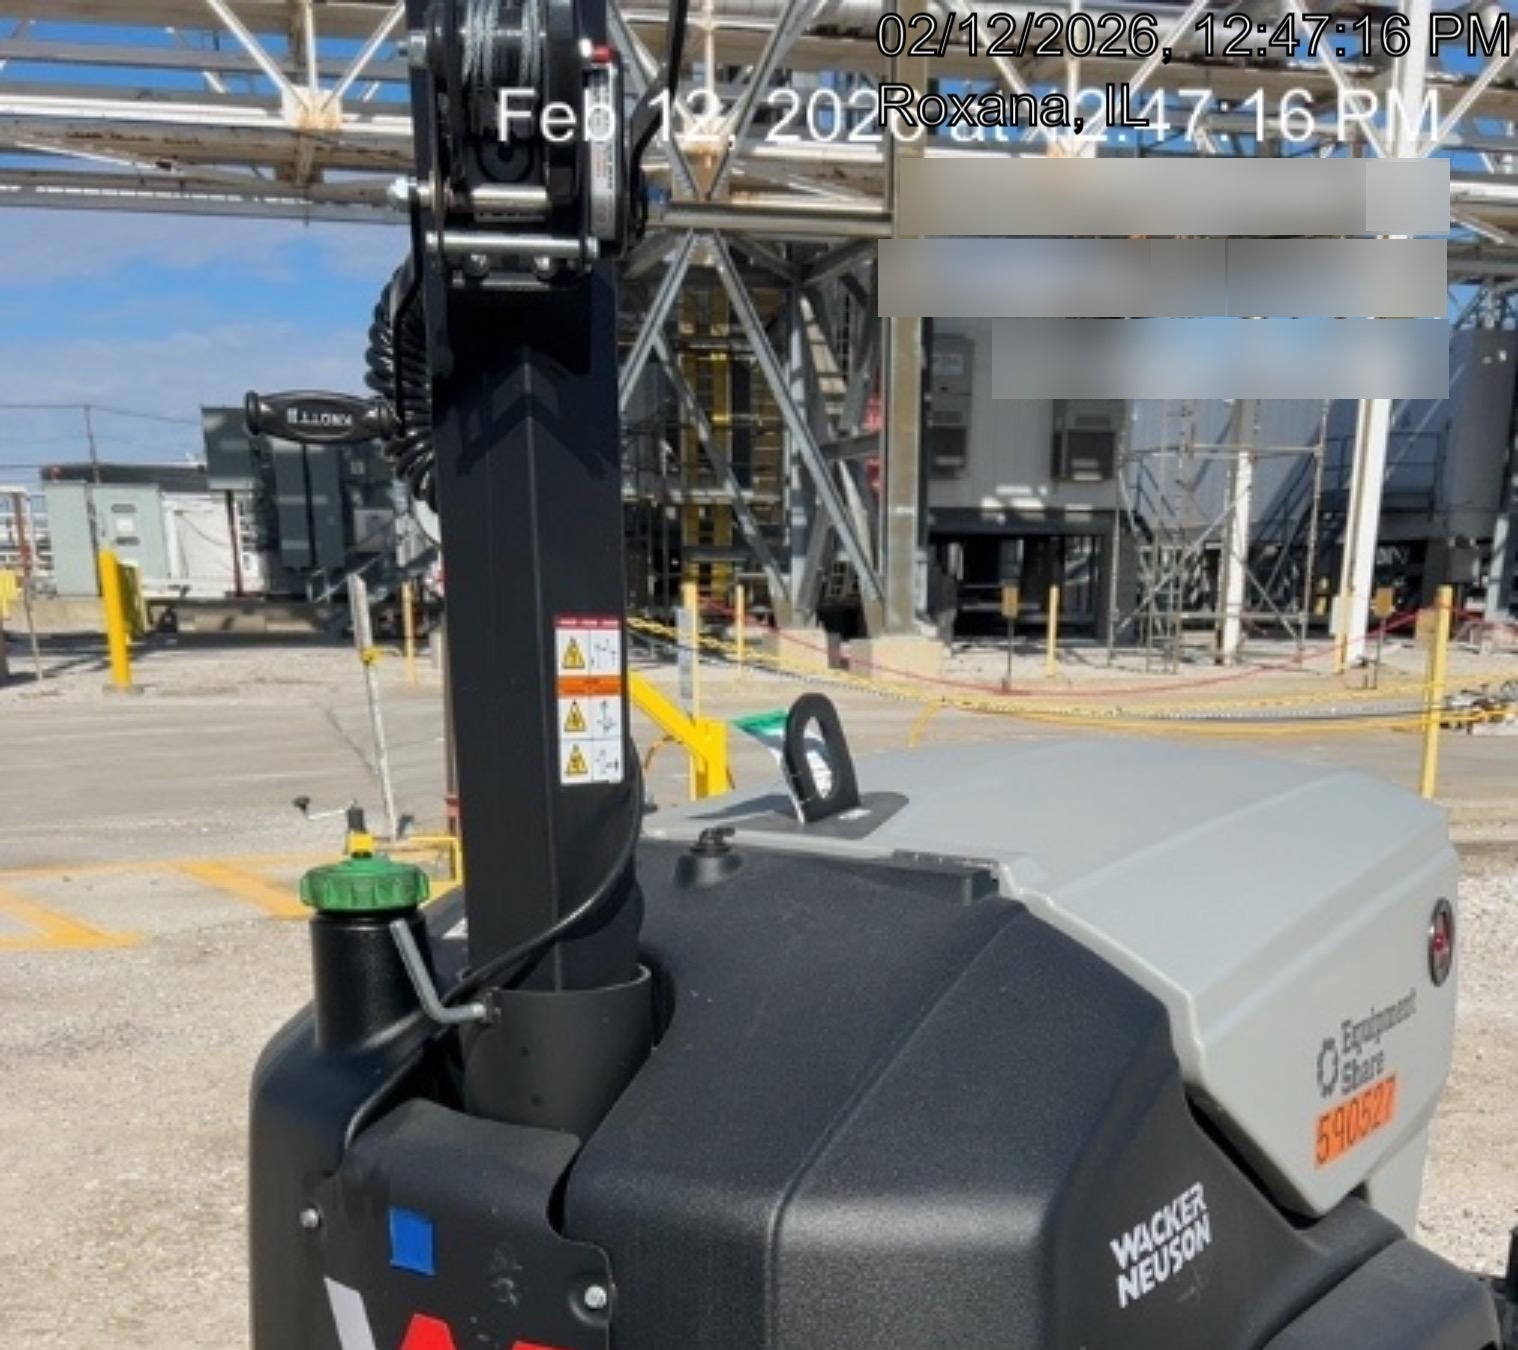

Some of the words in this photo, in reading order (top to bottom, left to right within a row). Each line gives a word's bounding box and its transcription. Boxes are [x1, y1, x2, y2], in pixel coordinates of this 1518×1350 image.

[1341, 987, 1417, 1055] Equipment
[1342, 1050, 1384, 1095] Share
[1109, 1181, 1207, 1270] WACKER
[1117, 1211, 1211, 1308] NEUSON
